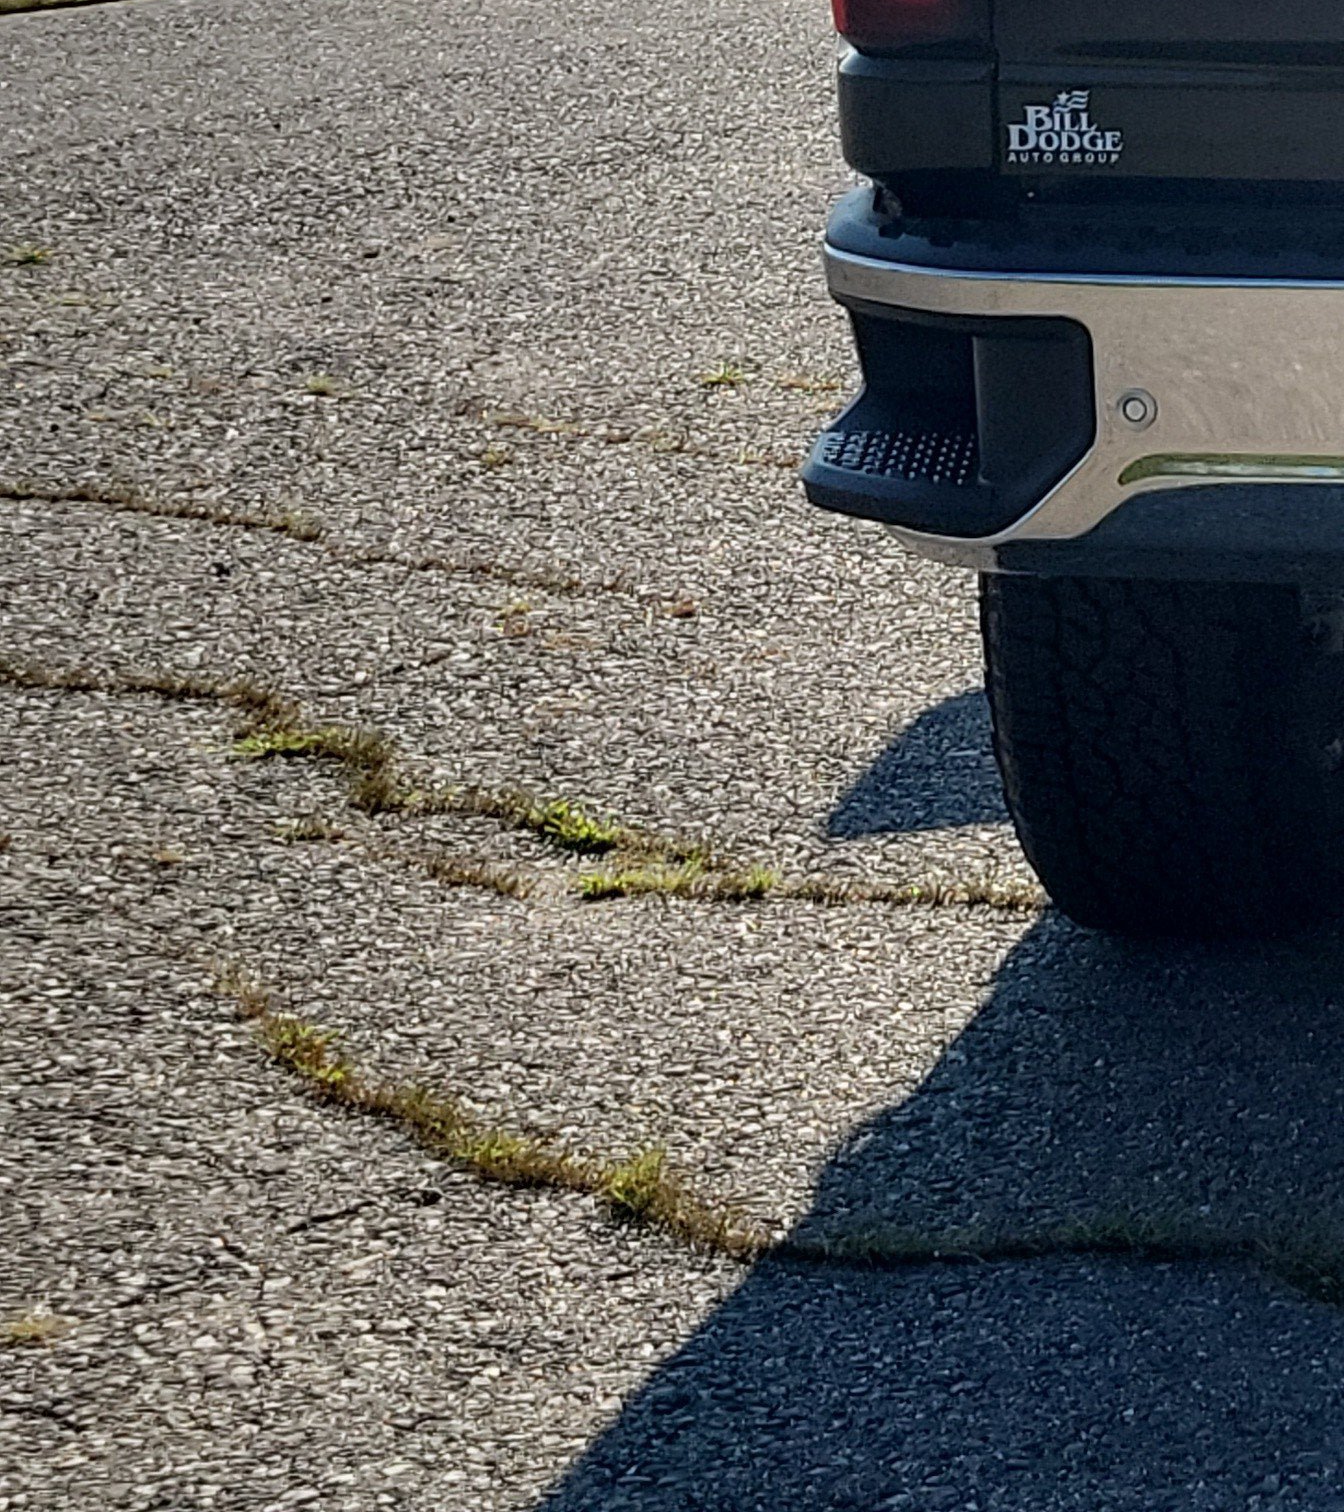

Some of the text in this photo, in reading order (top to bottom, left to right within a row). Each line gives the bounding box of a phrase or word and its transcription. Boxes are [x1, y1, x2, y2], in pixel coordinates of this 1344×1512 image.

[1023, 105, 1098, 131] BILL
[1007, 124, 1124, 152] DODGE
[1007, 152, 1120, 164] AUTO GROUP
